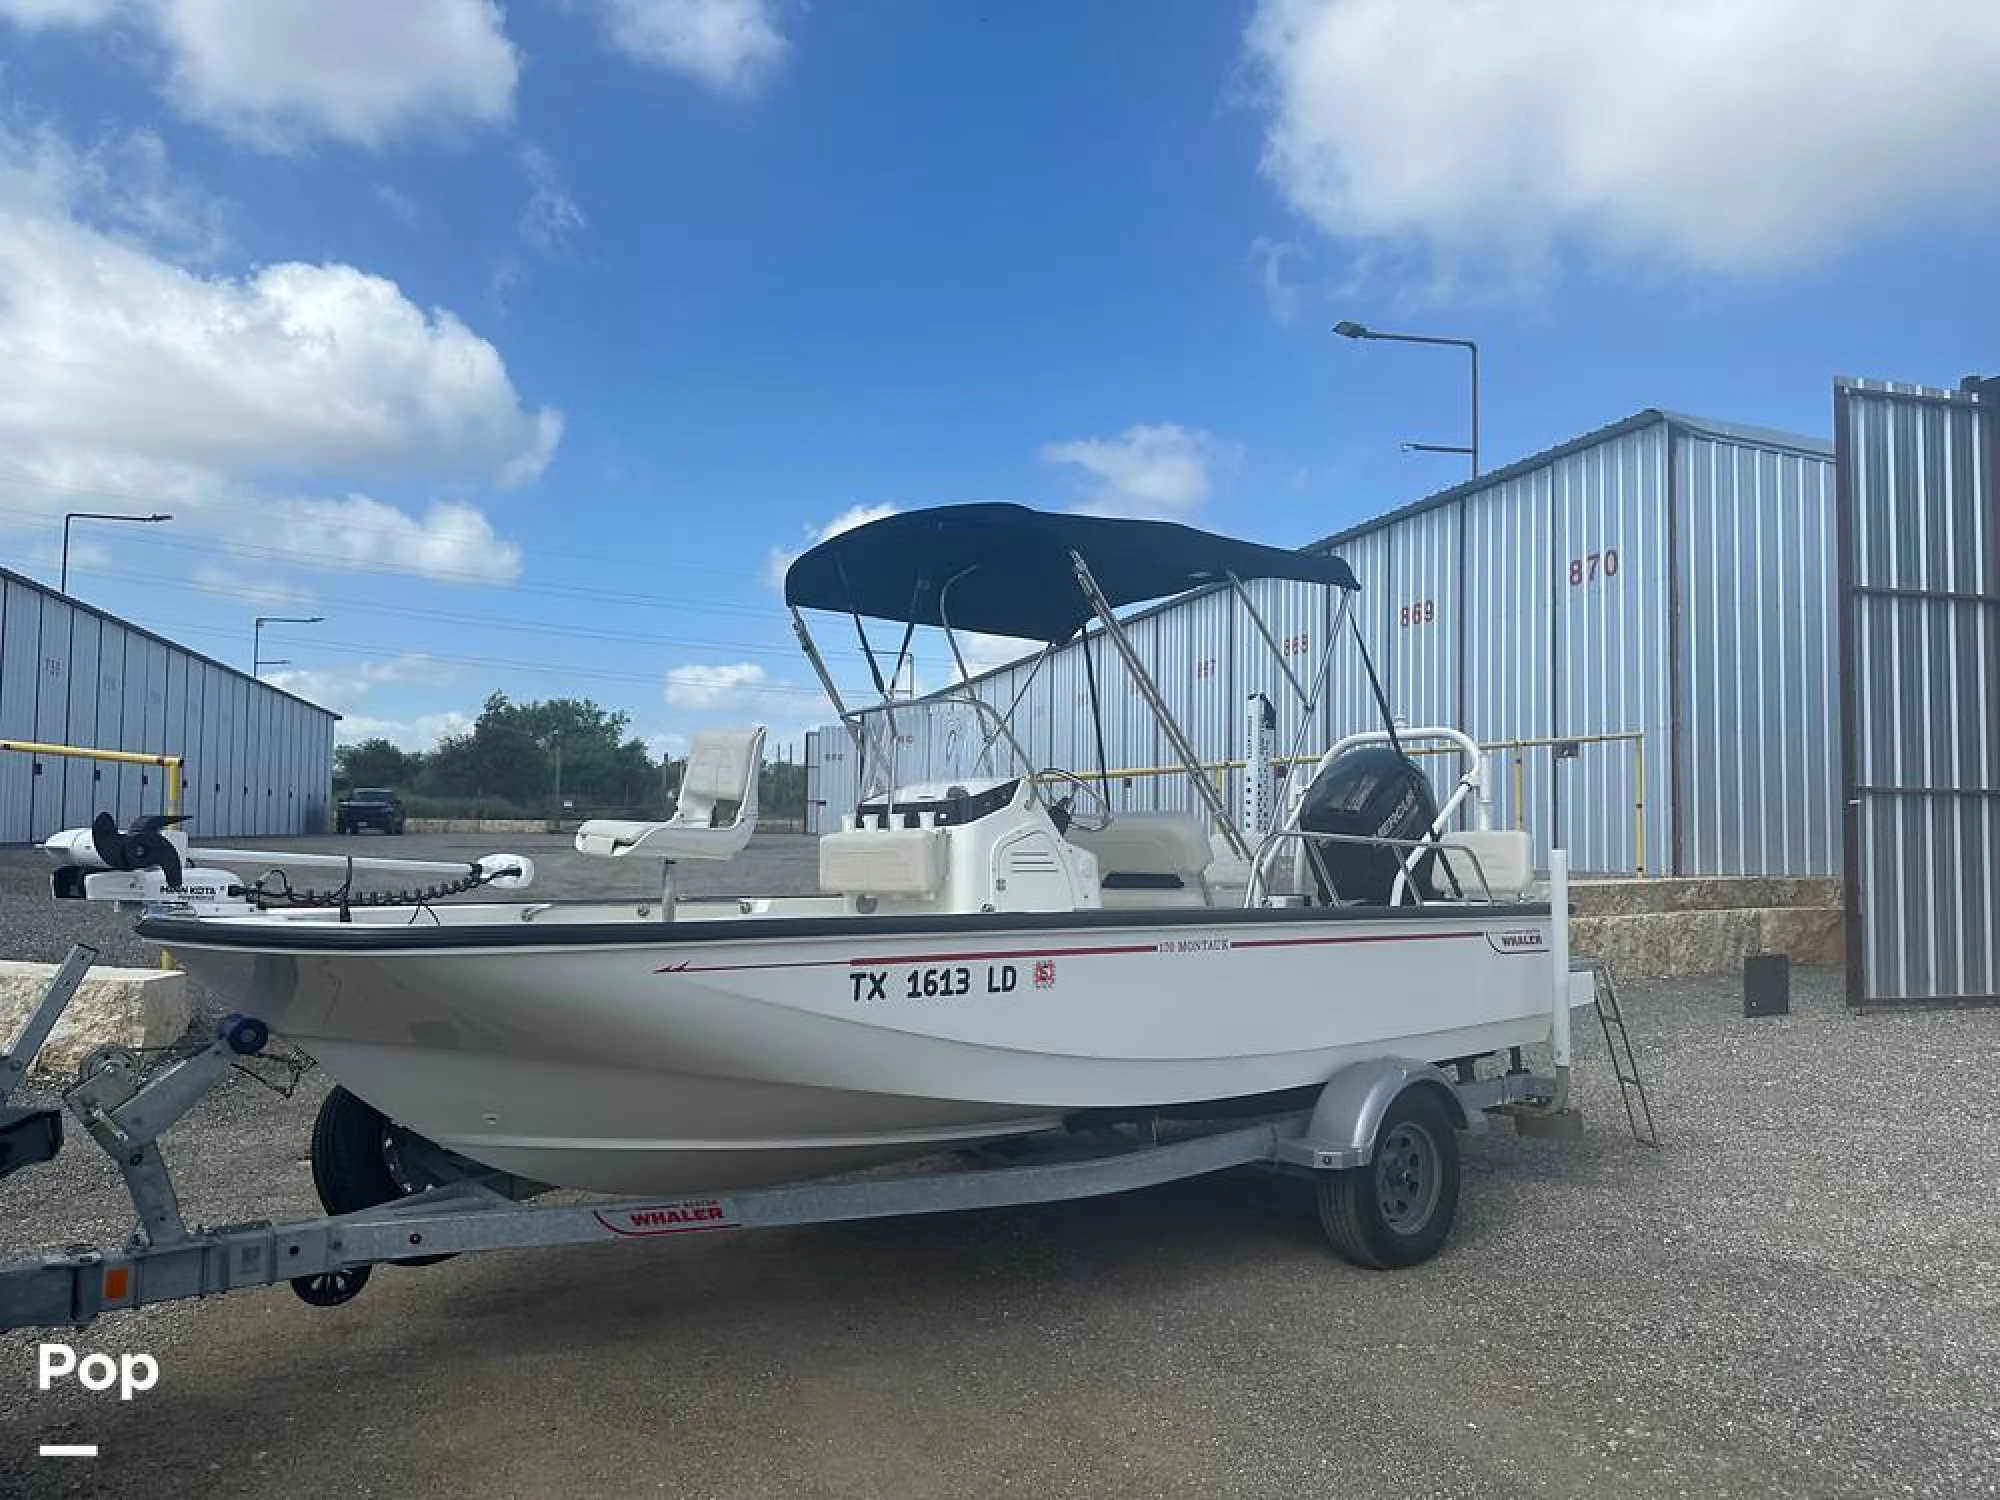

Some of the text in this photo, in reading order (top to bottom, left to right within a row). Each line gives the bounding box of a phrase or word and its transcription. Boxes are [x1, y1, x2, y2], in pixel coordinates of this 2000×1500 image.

[1569, 549, 1618, 586] 870
[1401, 600, 1434, 627] 869
[1502, 936, 1542, 947] WHALER
[850, 972, 887, 1001] TX
[907, 967, 971, 998] 1613
[987, 965, 1017, 992] LD
[629, 1208, 724, 1226] WHALER
